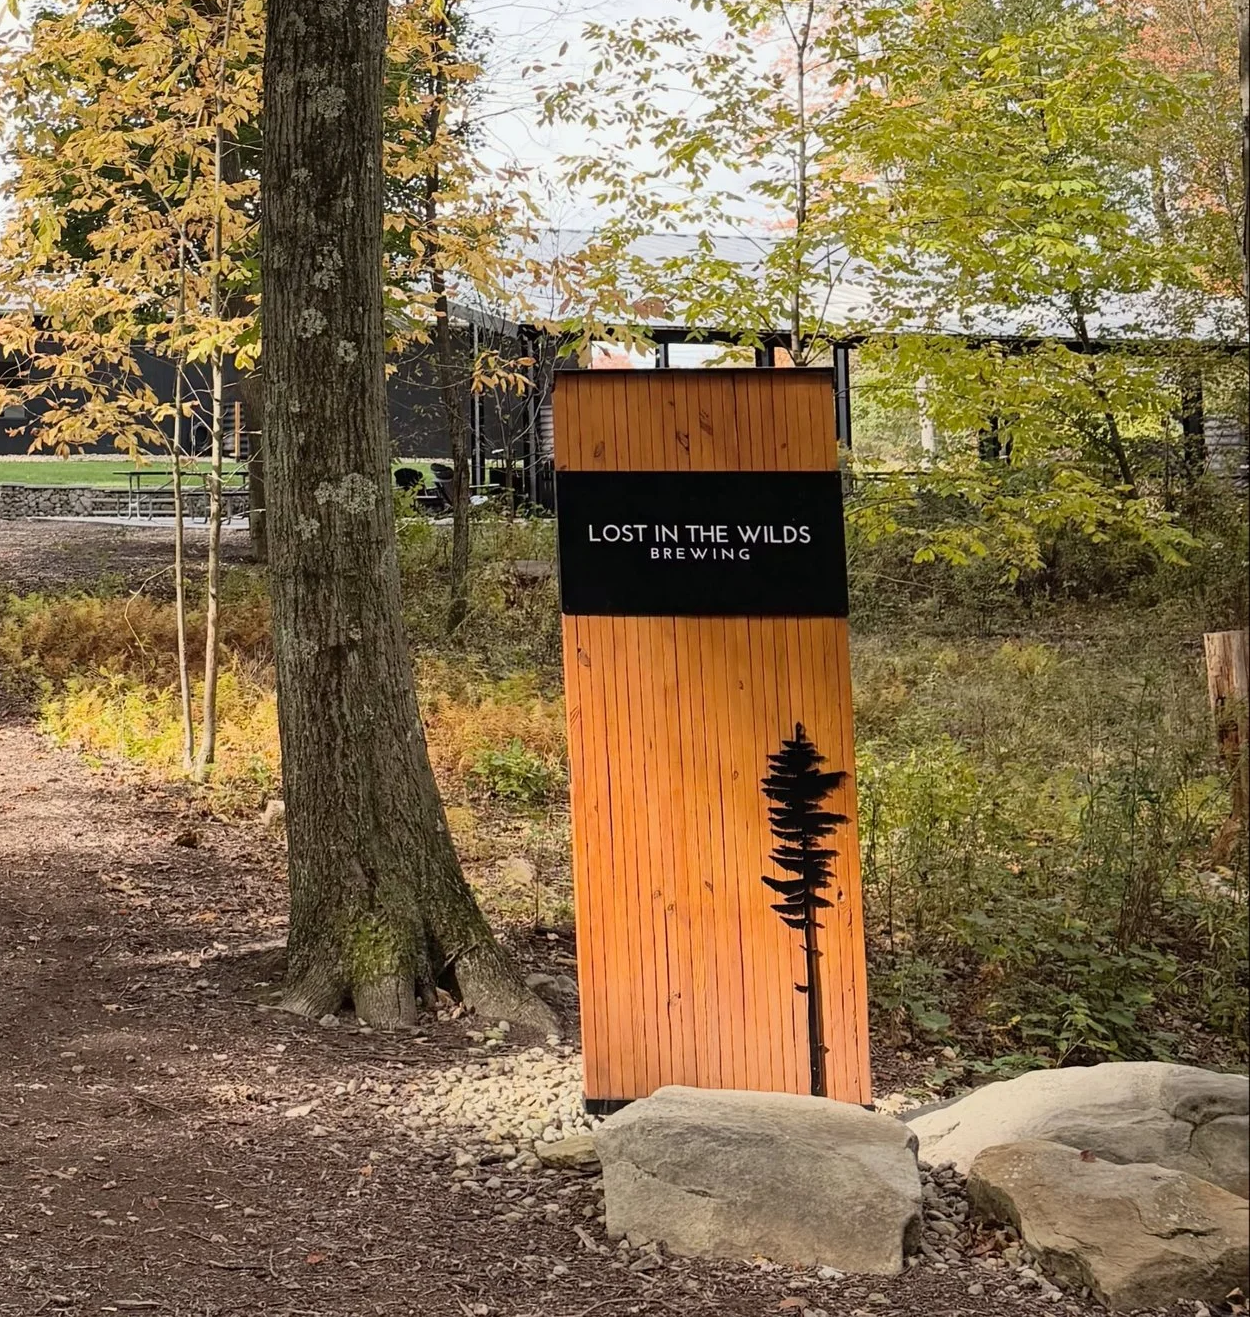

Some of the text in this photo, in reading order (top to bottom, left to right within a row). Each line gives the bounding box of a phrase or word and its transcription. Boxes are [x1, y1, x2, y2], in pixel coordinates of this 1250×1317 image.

[588, 524, 811, 544] LOST IN THE WILDS
[650, 547, 750, 560] BREWING
